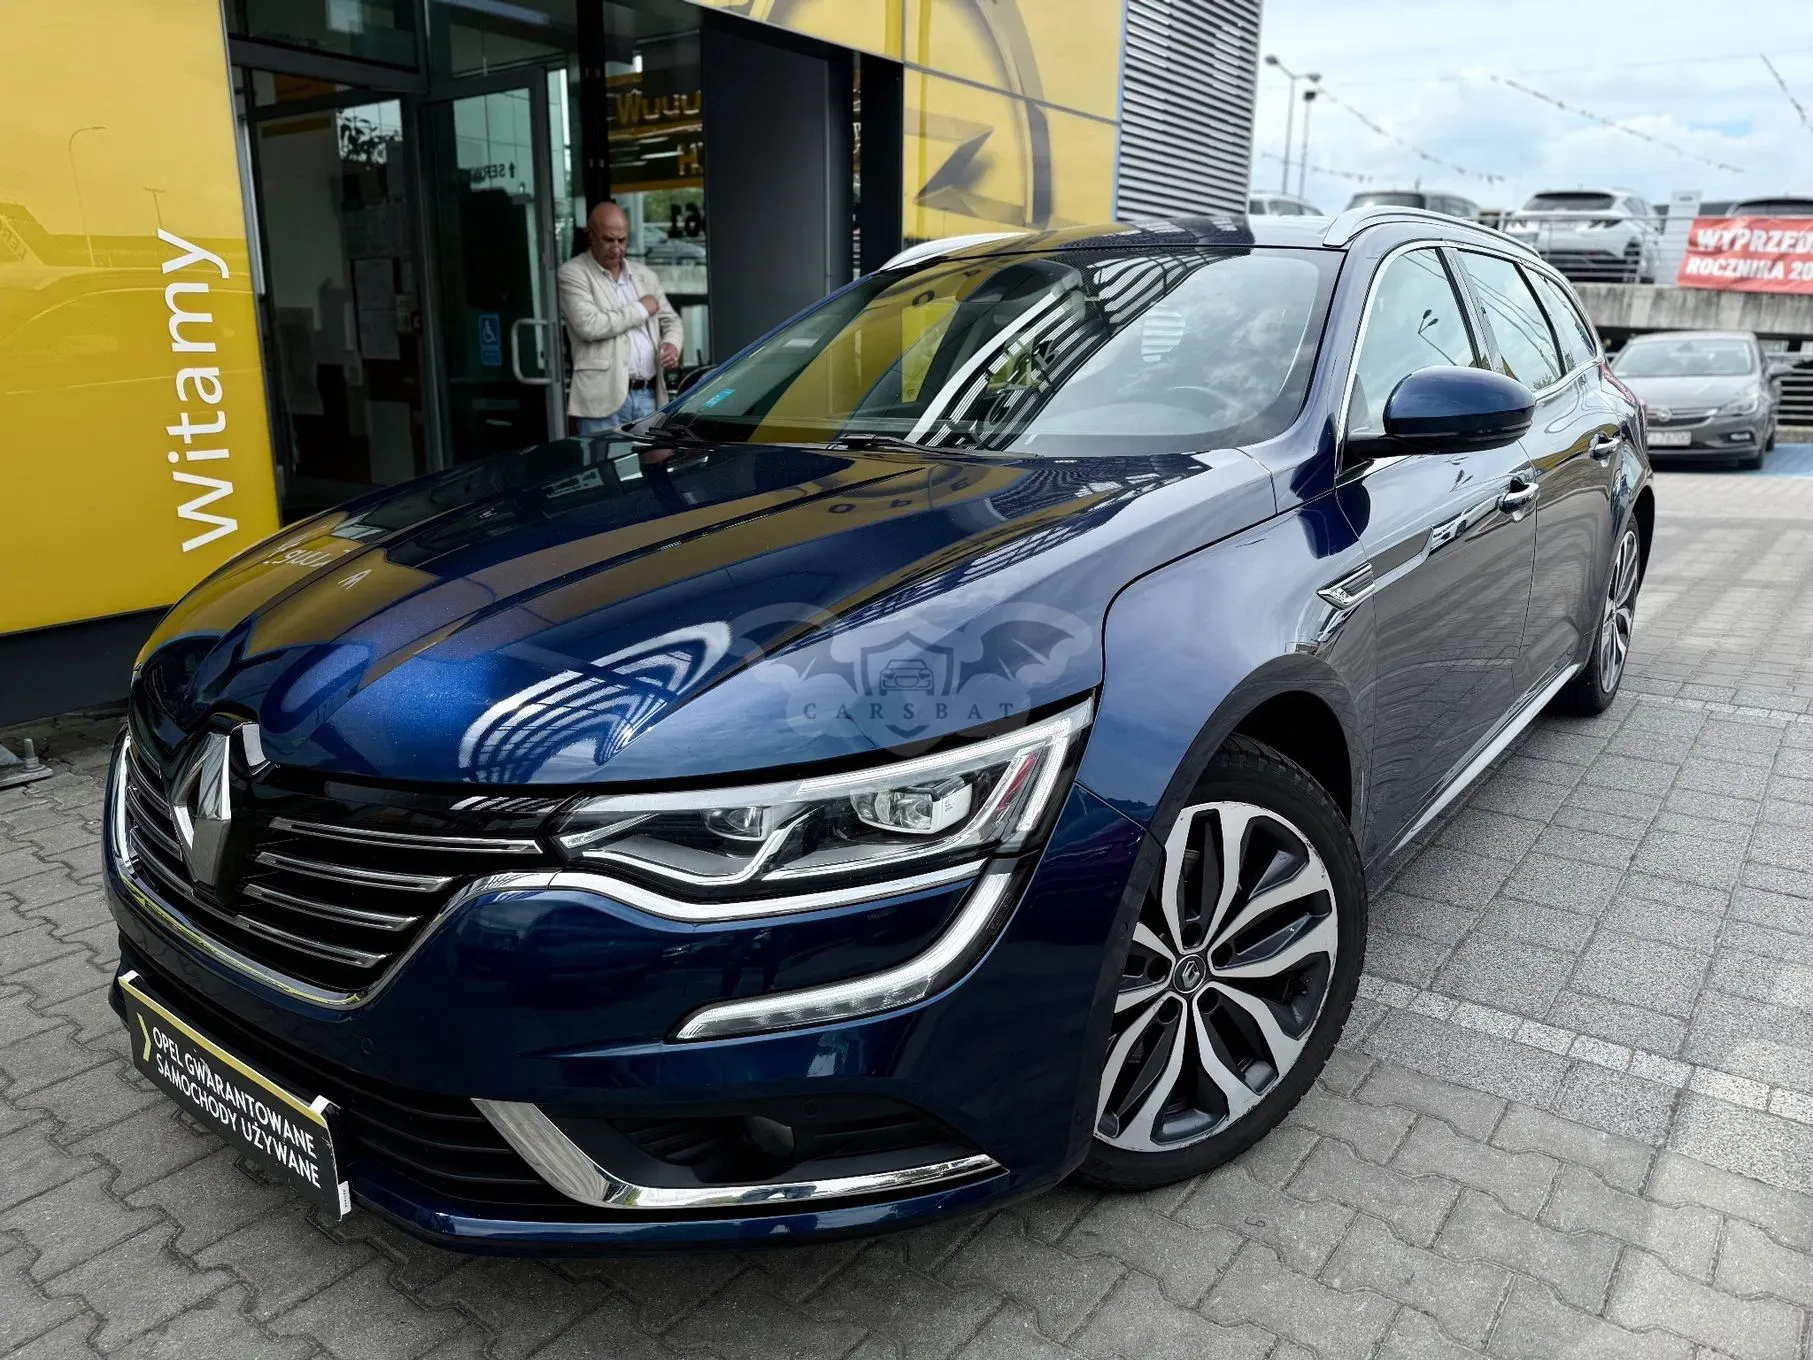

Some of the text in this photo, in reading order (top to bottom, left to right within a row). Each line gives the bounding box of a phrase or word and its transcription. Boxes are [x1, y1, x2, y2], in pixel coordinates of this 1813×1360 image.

[157, 228, 238, 552] Witamy
[153, 1027, 317, 1159] OPEL GWARANTOWANE
[156, 1053, 321, 1188] SAMOCHODY UŻYWANE
